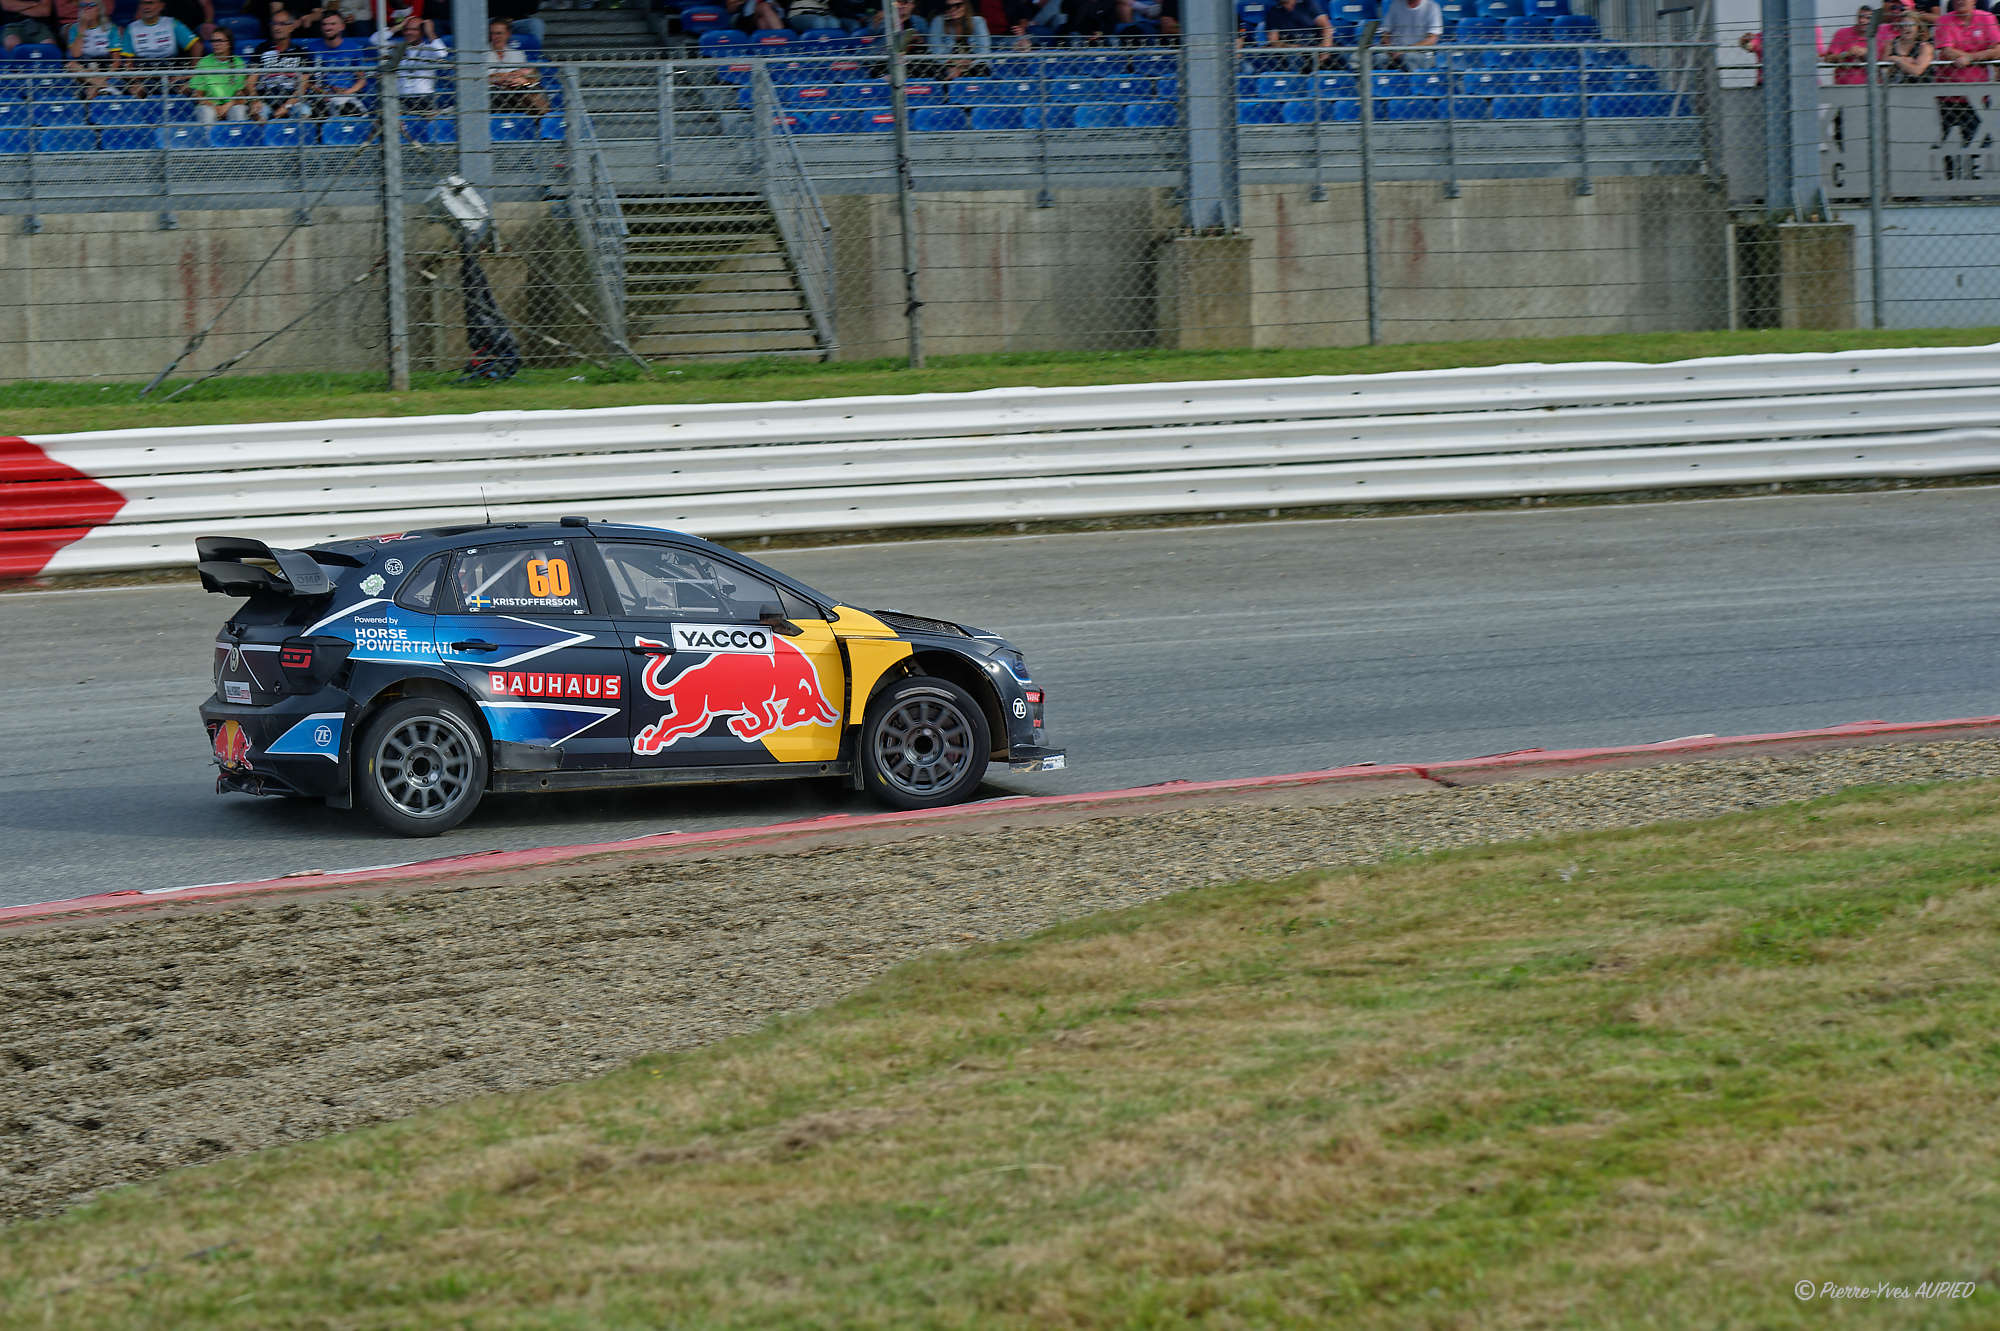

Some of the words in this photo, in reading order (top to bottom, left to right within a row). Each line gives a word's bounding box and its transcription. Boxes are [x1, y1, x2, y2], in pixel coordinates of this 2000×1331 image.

[526, 558, 571, 598] 60
[492, 597, 578, 606] KRISTOFFERSSON
[354, 616, 388, 624] Powered
[388, 617, 399, 626] by
[354, 628, 408, 640] HORSE
[678, 629, 767, 650] YACCO
[491, 674, 620, 696] BAUHAUS
